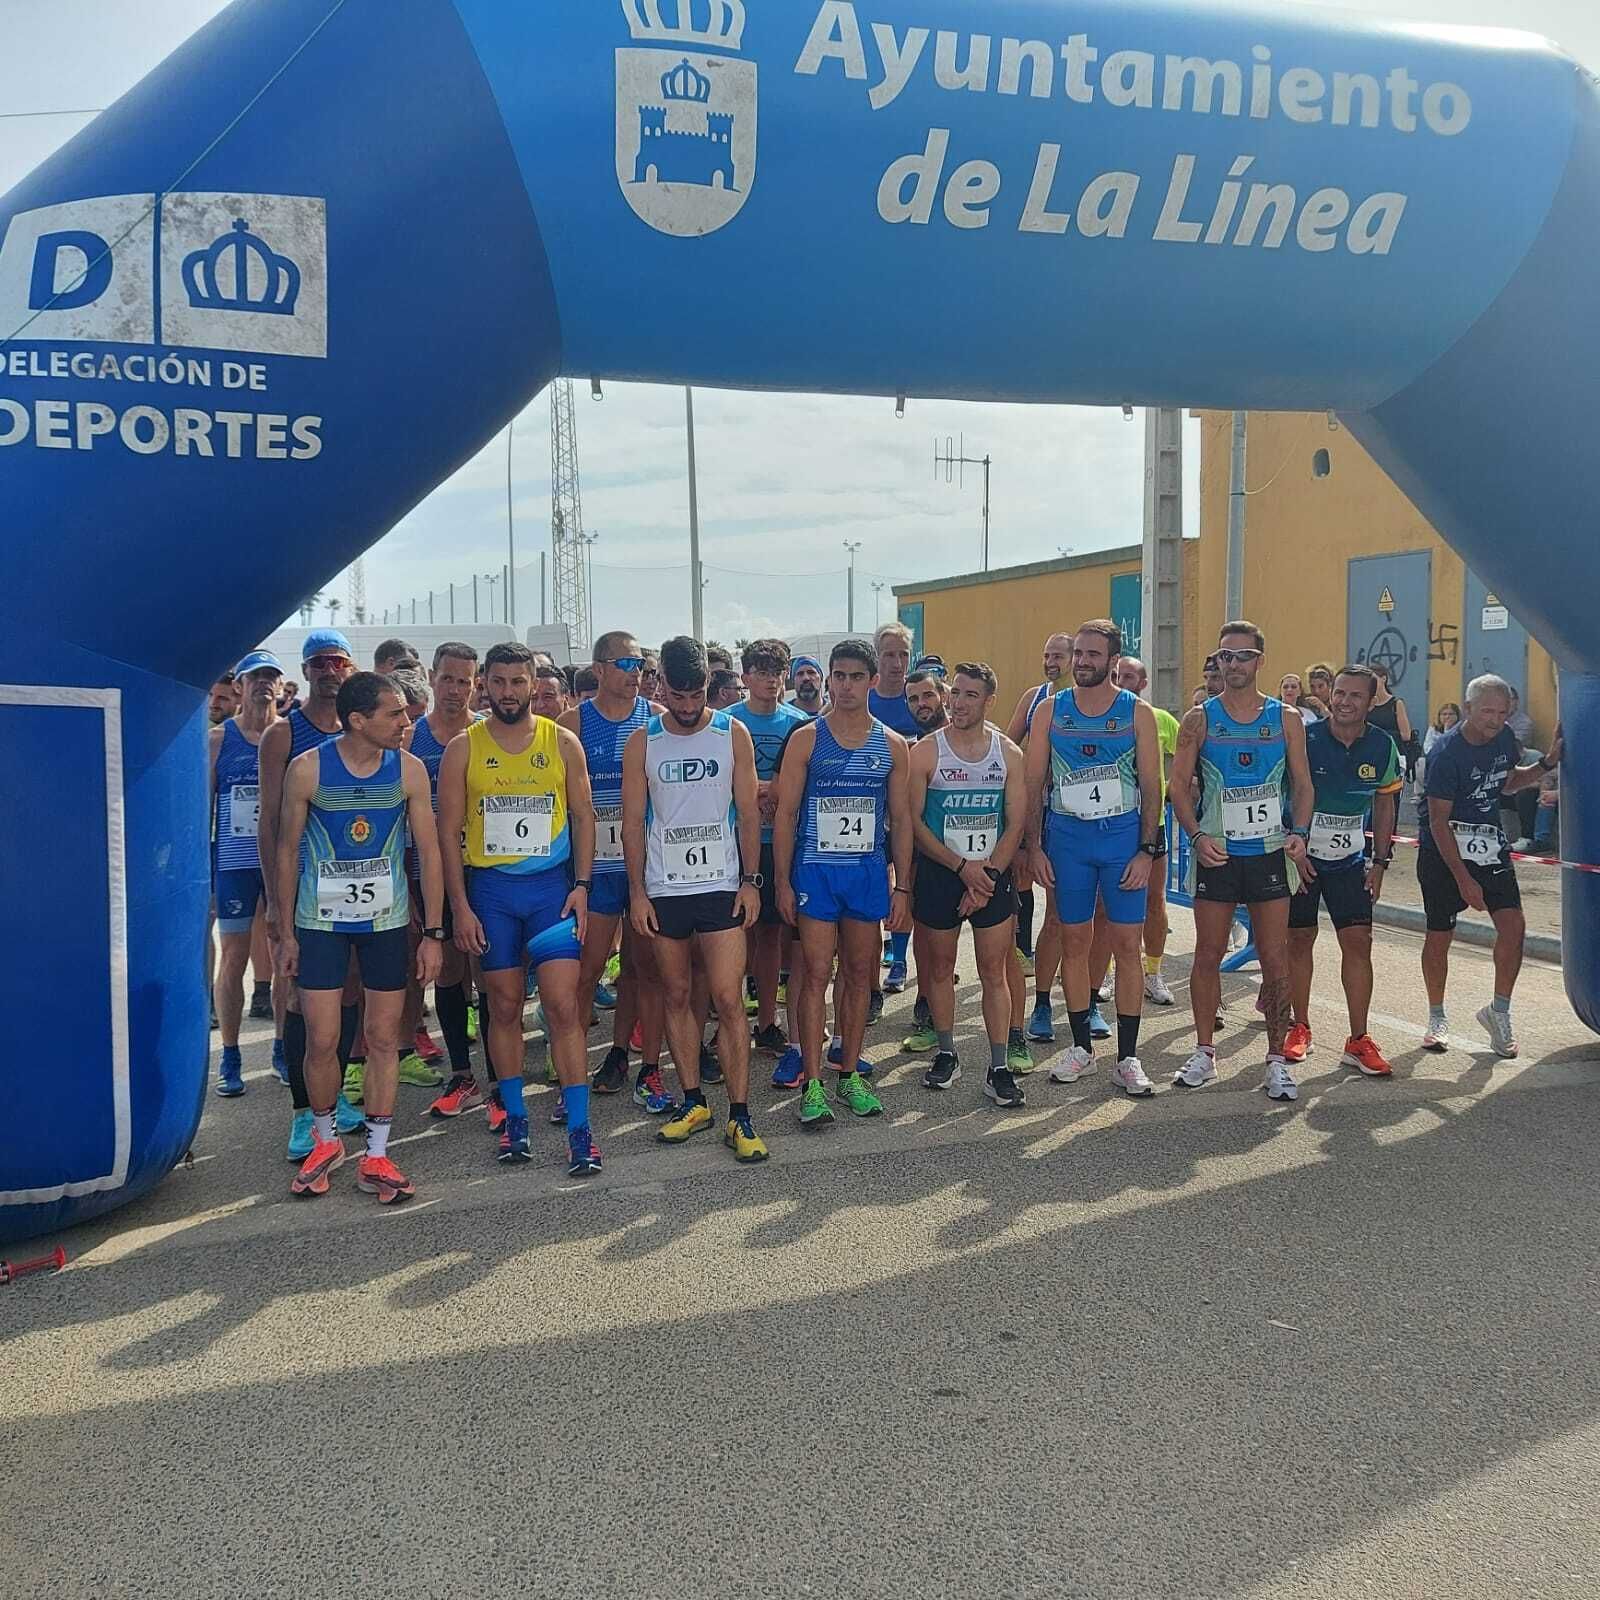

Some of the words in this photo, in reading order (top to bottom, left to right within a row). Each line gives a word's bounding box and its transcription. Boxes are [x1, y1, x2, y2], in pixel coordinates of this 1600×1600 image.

[794, 0, 1472, 136] Ayuntamiento
[877, 128, 1000, 229] de
[1018, 143, 1141, 239] La
[1152, 154, 1408, 256] Línea
[28, 230, 113, 311] D
[0, 350, 211, 387] ELEGACIÓN
[222, 362, 267, 391] DE
[0, 398, 323, 460] DEPORTES
[1089, 785, 1101, 803] 4
[1246, 803, 1268, 824] 15
[515, 817, 529, 838] 6
[839, 817, 863, 836] 24
[967, 834, 987, 852] 13
[1329, 833, 1352, 849] 58
[1467, 839, 1488, 854] 63
[685, 846, 709, 866] 61
[345, 882, 376, 904] 35
